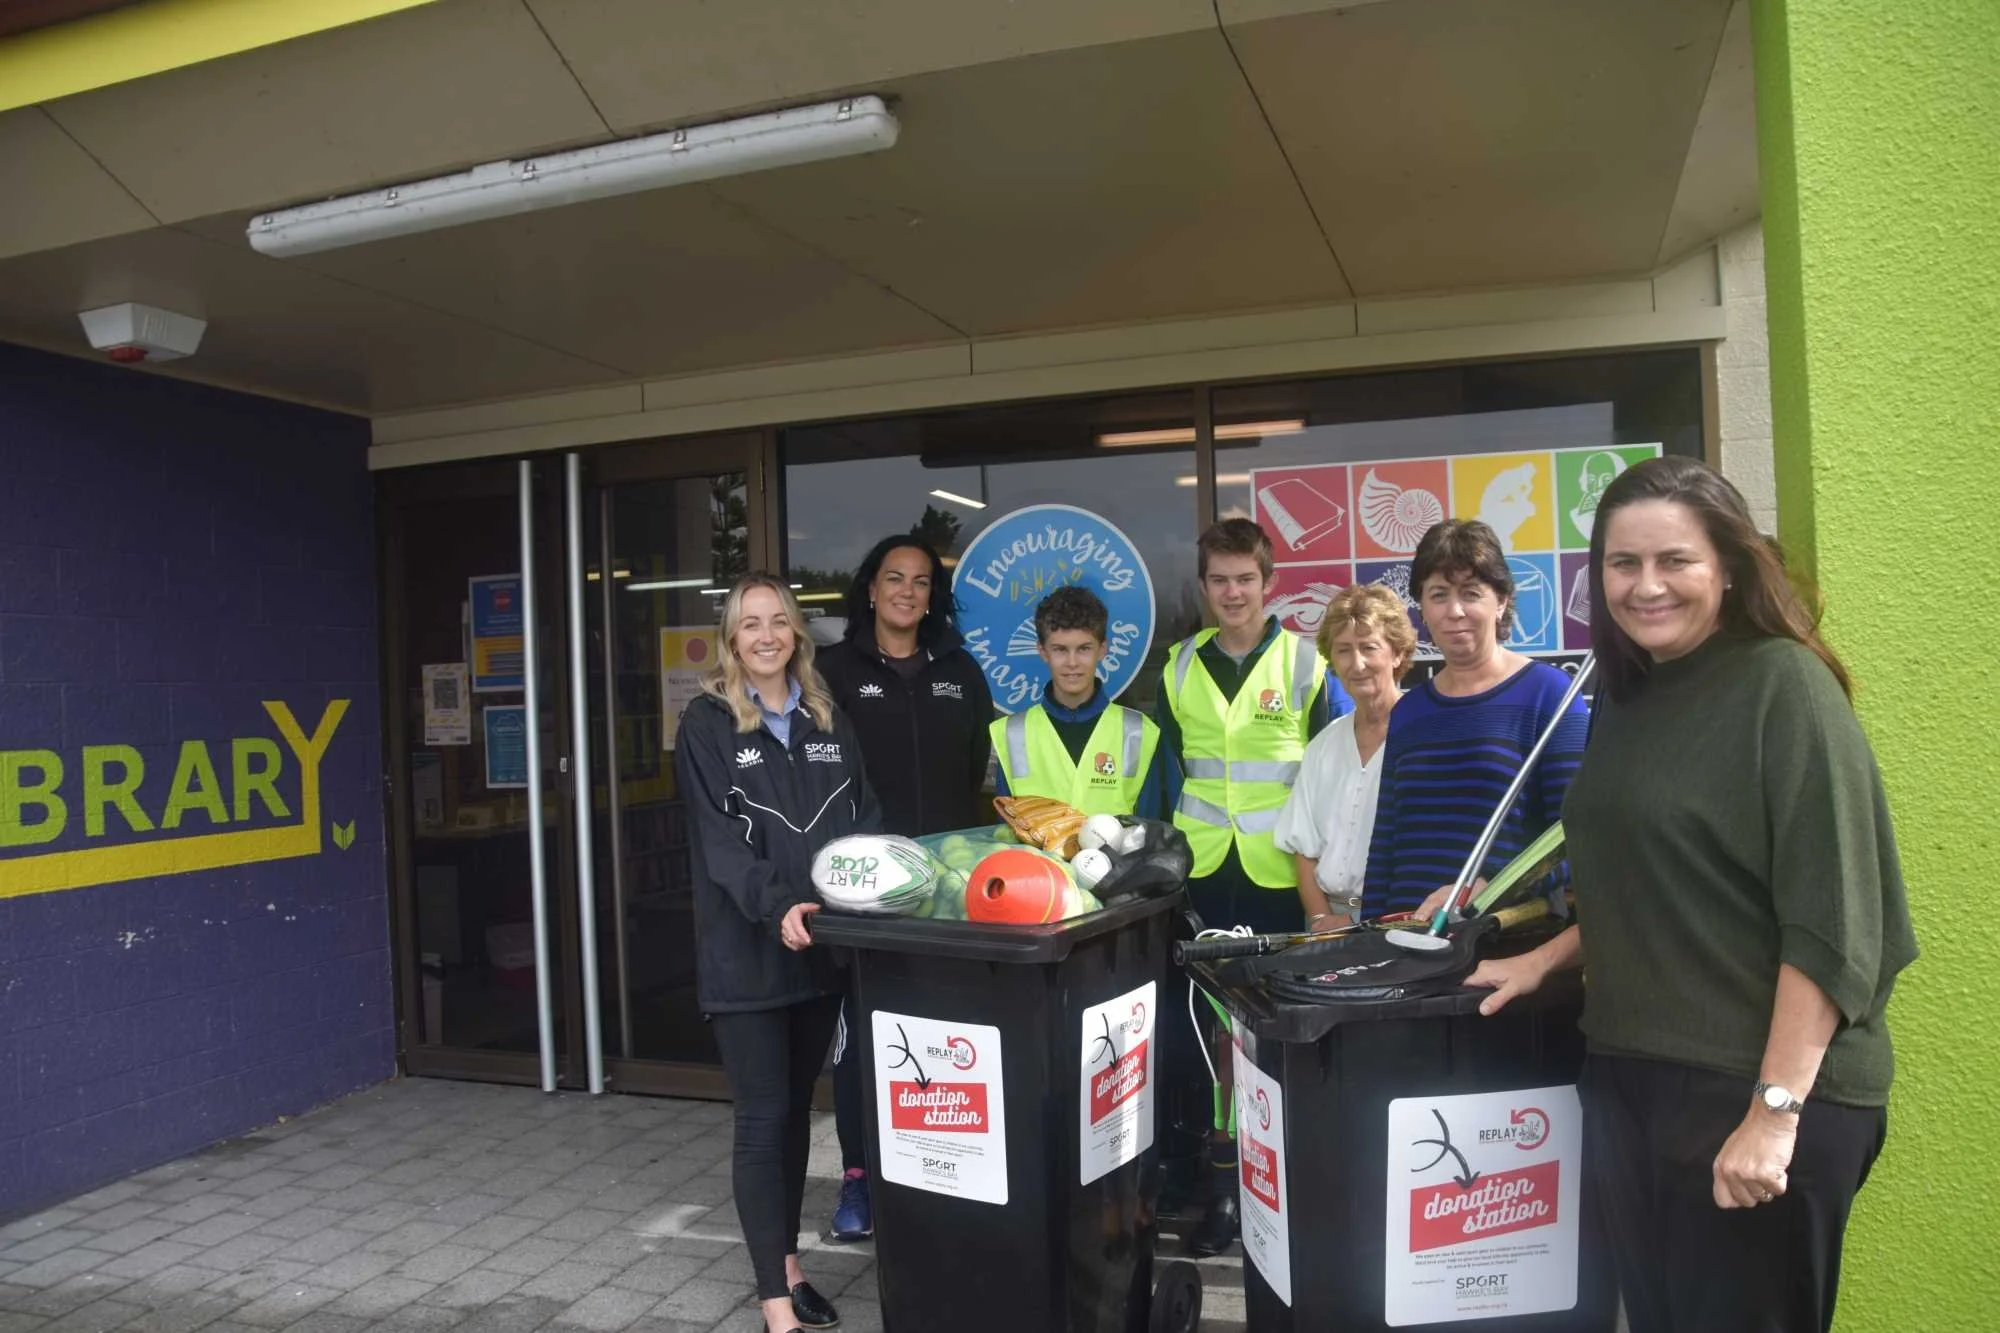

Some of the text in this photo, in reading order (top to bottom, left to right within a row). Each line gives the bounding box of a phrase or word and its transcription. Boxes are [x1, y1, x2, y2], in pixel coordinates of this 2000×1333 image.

[965, 524, 1136, 598] Encouraging
[932, 682, 962, 693] SPORT
[1254, 713, 1284, 722] REPLAY
[805, 743, 841, 754] SPORT
[1091, 777, 1117, 785] REPLAY
[830, 855, 880, 876] CLUB
[826, 872, 877, 889] HART
[927, 1046, 953, 1058] REPLAY
[1096, 1056, 1141, 1099] donation
[1111, 1069, 1145, 1105] station
[899, 1086, 970, 1108] donation
[923, 1106, 983, 1126] station
[1479, 1127, 1517, 1141] REPLAY
[922, 1157, 957, 1172] SPORT
[1424, 1176, 1535, 1220] donation
[1462, 1197, 1549, 1234] station
[1456, 1274, 1508, 1290] SPORT
